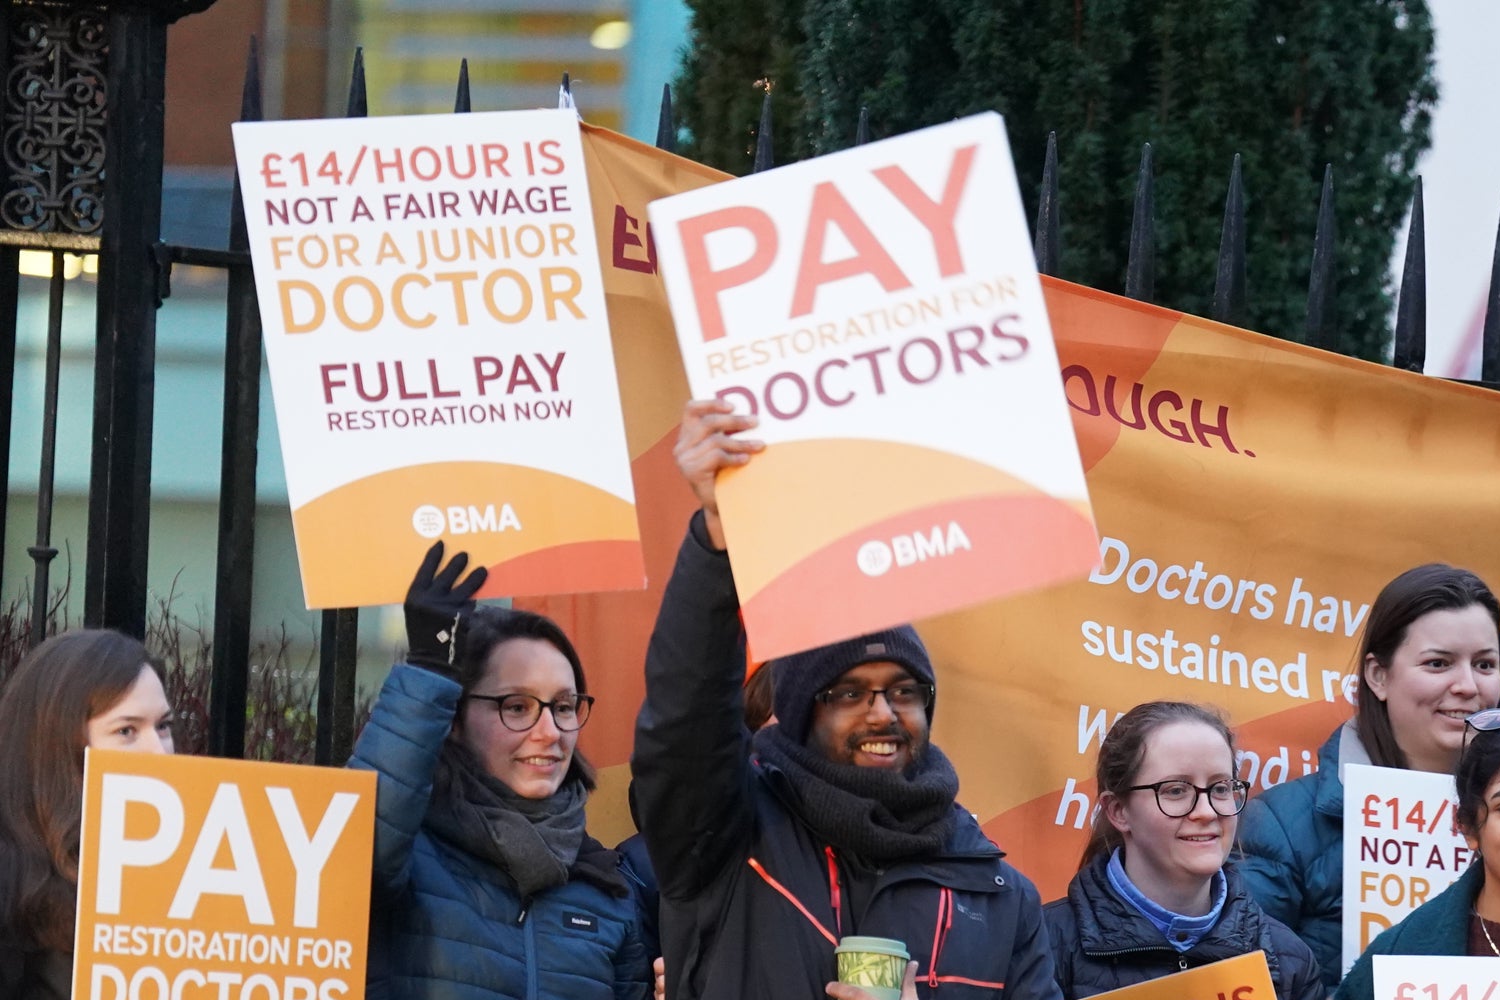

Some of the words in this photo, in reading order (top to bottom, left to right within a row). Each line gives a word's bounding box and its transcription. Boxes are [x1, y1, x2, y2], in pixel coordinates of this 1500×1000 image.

[260, 143, 511, 188] £14/HOUR
[525, 140, 564, 176] IS
[265, 195, 339, 226] NOT
[351, 195, 375, 223] A
[384, 190, 461, 221] FAIR
[469, 186, 571, 215] WAGE
[270, 232, 361, 270] FOR
[376, 231, 405, 265] A
[417, 223, 578, 269] JUNIOR
[677, 144, 981, 343] PAY
[277, 266, 587, 334] DOCTOR
[706, 299, 943, 378] RESTORATION
[953, 275, 1020, 311] FOR
[320, 358, 461, 403] FULL
[474, 352, 566, 396] PAY
[715, 314, 1030, 422] DOCTORS
[327, 404, 506, 431] RESTORATION
[515, 400, 573, 421] NOW
[448, 504, 521, 534] BMA
[892, 521, 971, 567] BMA
[1088, 537, 1278, 620] Doctors
[1284, 578, 1370, 637] hav
[1081, 620, 1309, 699] sustained
[96, 773, 360, 928] PAY
[1361, 836, 1418, 866] NOT
[1426, 845, 1445, 870] A
[1361, 871, 1431, 908] FOR
[93, 924, 289, 964] RESTORATION
[297, 938, 352, 968] FOR
